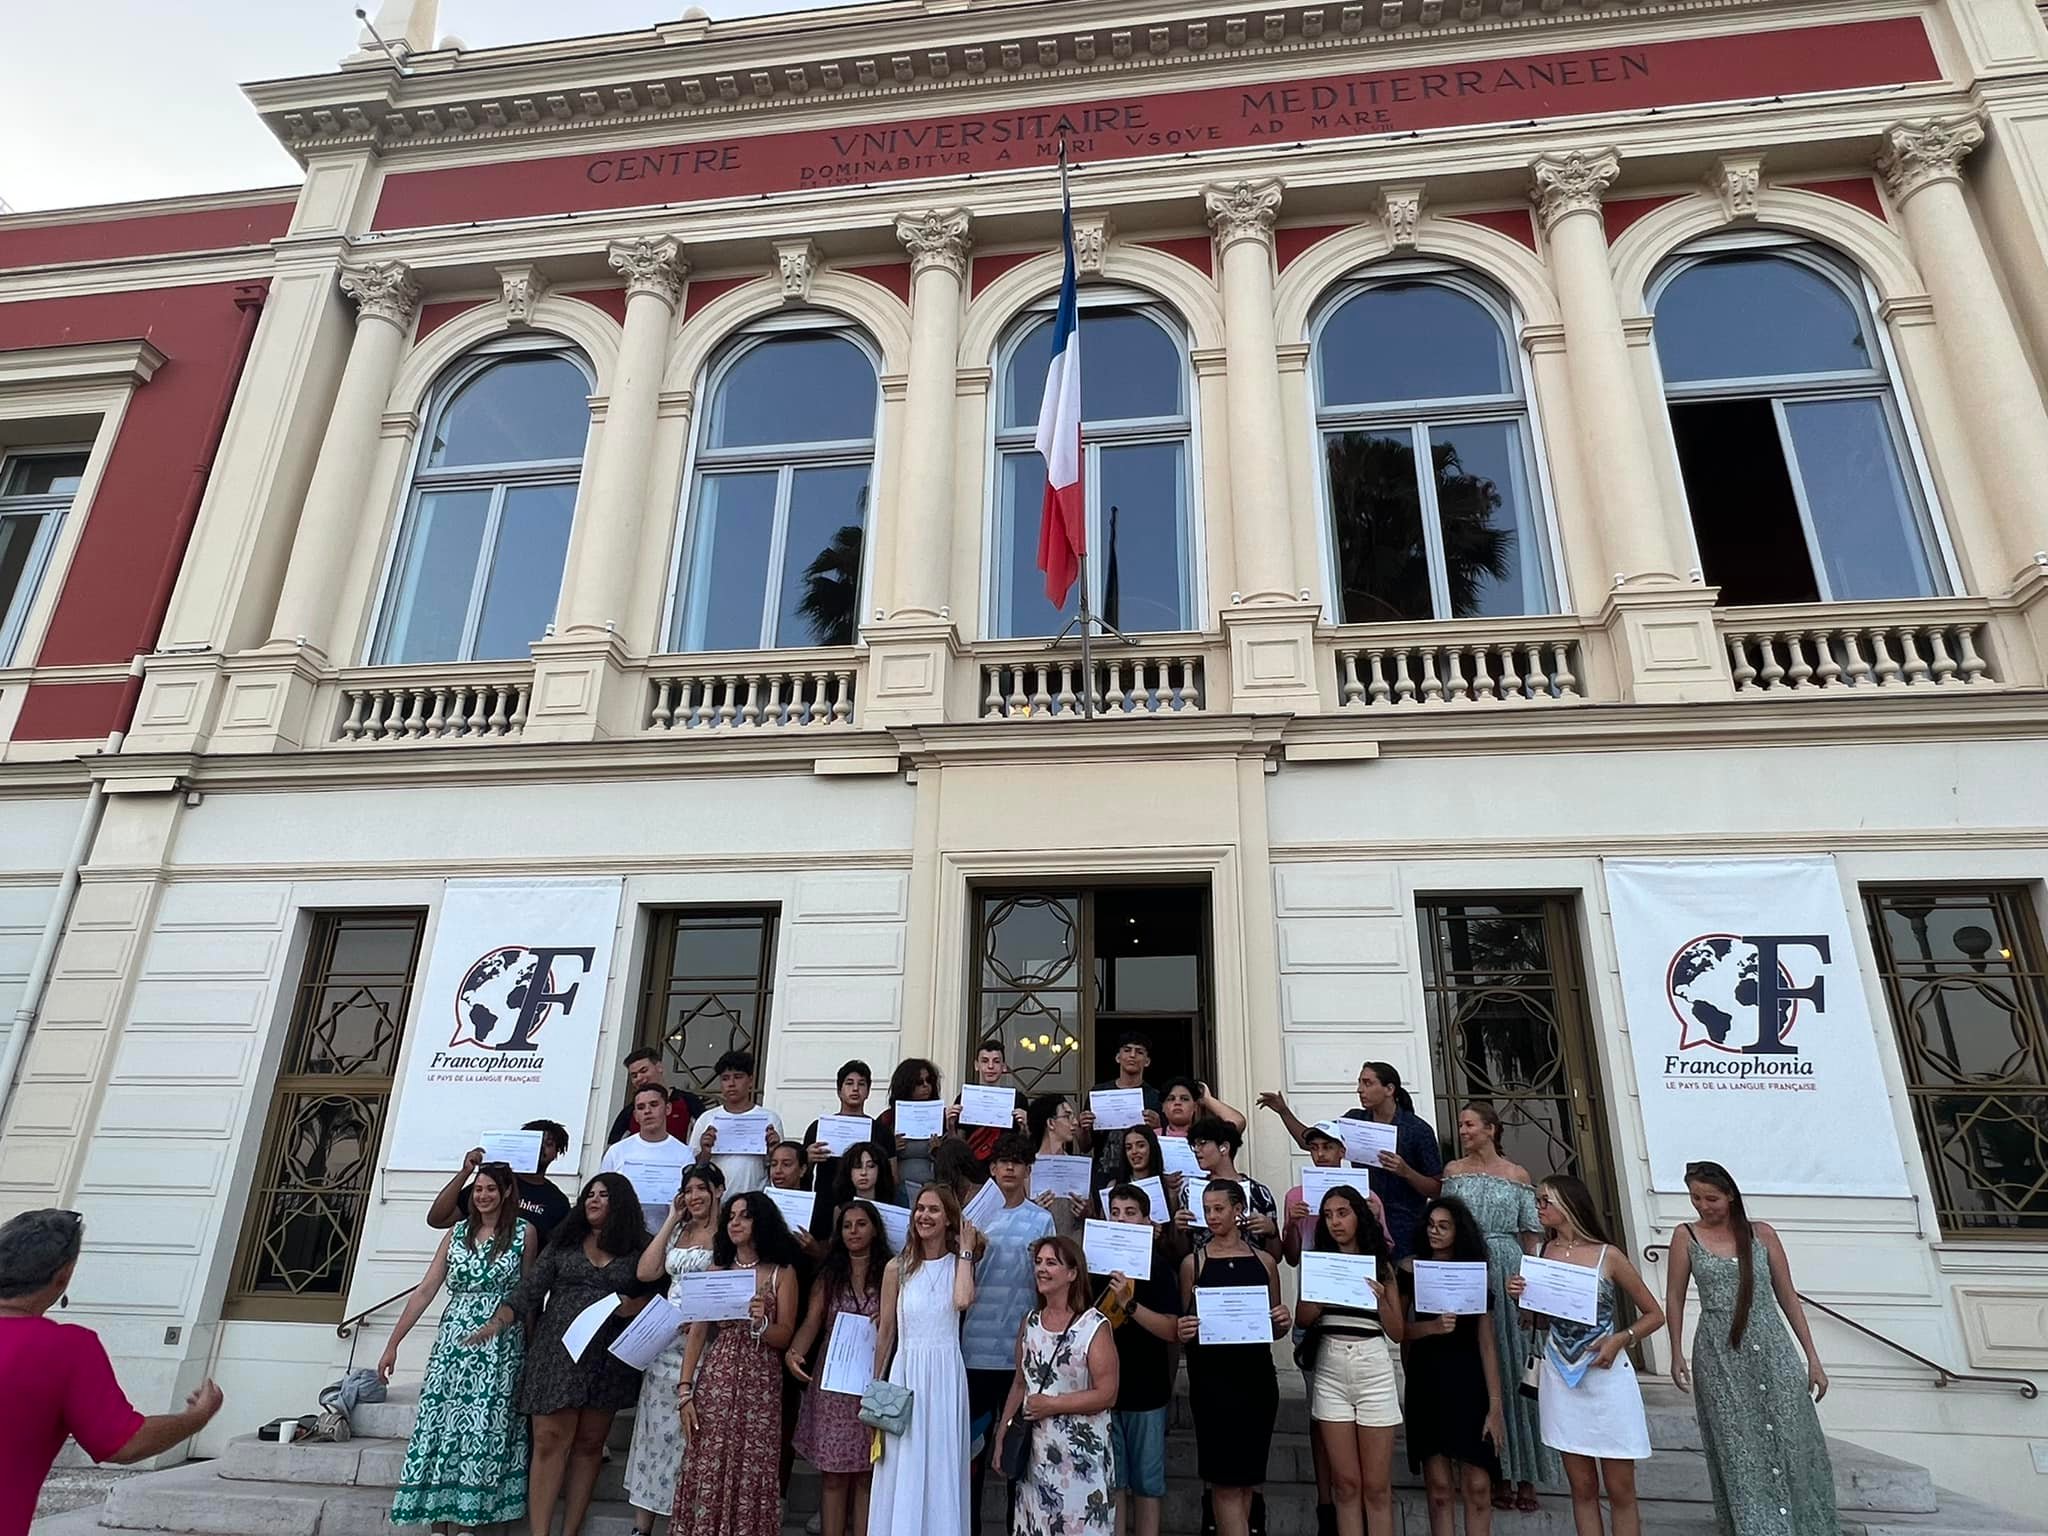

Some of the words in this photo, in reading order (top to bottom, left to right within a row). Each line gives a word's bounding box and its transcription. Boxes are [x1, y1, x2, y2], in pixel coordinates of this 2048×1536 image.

[587, 145, 742, 184] CENTRE
[1241, 53, 1650, 119] MEDITERRANEEN
[800, 152, 971, 180] DOMINABITVR
[998, 149, 1012, 160] A
[1036, 138, 1094, 158] MRI
[1248, 119, 1284, 136] AD
[1311, 108, 1392, 129] MARE
[430, 1052, 545, 1072] Francophonia
[1664, 1055, 1814, 1079] Francophonia
[1666, 1081, 1676, 1090] LE
[1679, 1081, 1699, 1090] PAYS
[1702, 1081, 1713, 1090] DE
[1717, 1082, 1728, 1090] LA
[1730, 1082, 1765, 1091] LANGUE
[1768, 1082, 1817, 1092] FRANÇAISE
[519, 1198, 545, 1215] hlete
